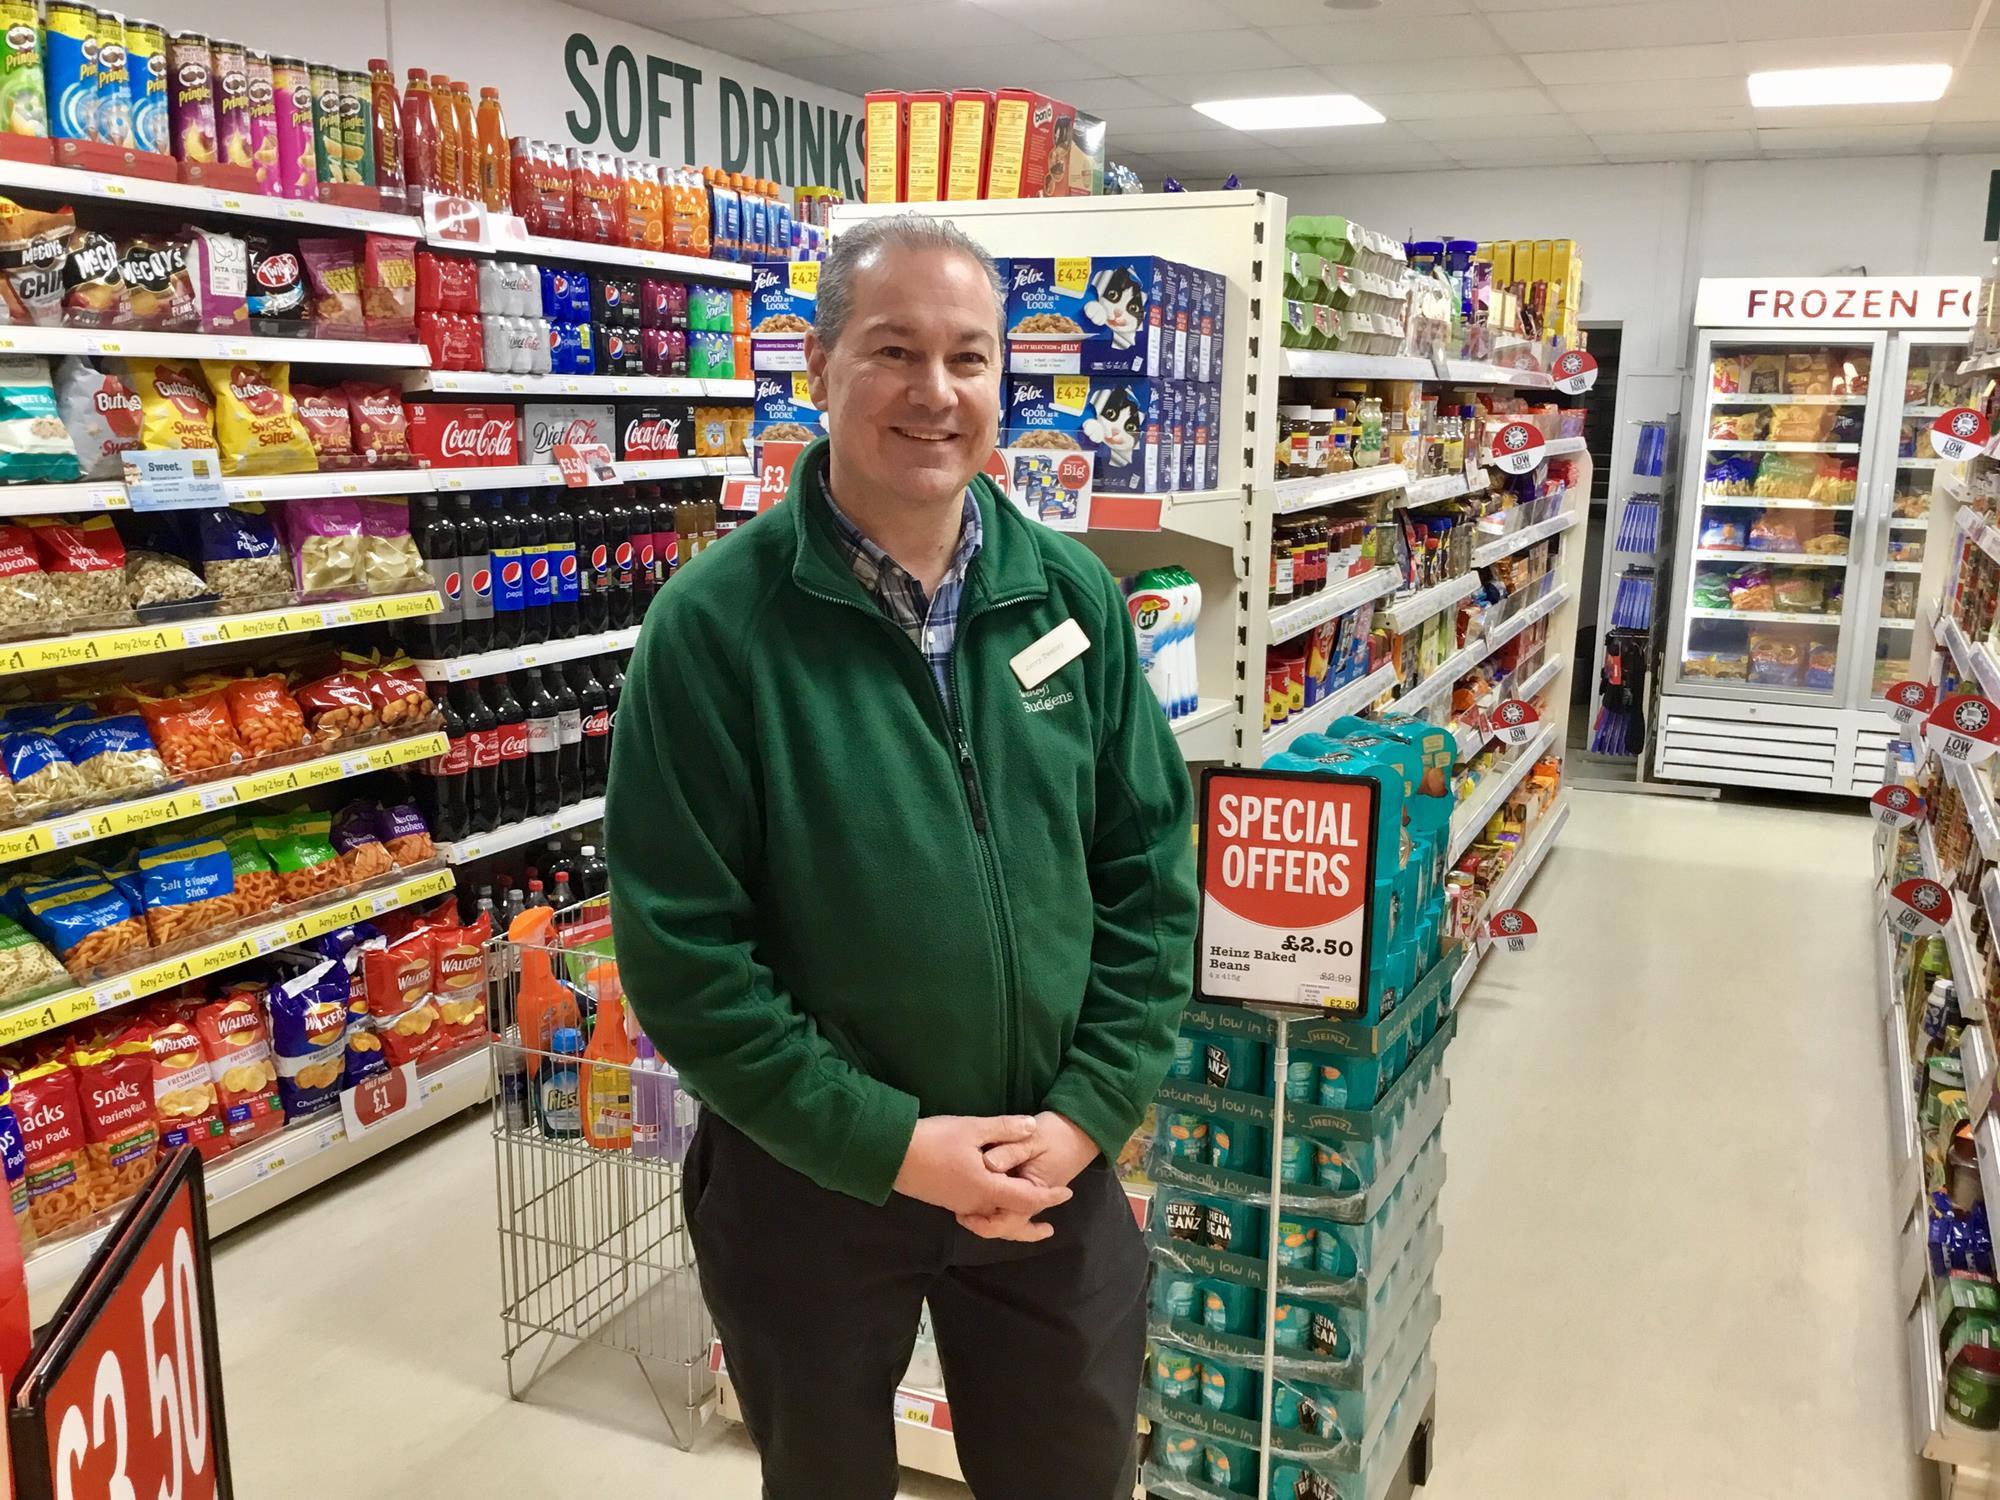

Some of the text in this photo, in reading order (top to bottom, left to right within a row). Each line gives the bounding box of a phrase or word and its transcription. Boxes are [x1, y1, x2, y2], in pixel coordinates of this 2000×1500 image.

[565, 33, 702, 166] SOFT
[791, 272, 818, 285] £4.25
[1057, 269, 1088, 282] £4.25
[761, 294, 783, 303] GOOD
[1022, 292, 1047, 302] GOOD
[1747, 289, 1918, 318] FROZEN
[1060, 344, 1079, 353] JELLY
[1056, 386, 1087, 399] £4.25
[414, 406, 424, 416] 10
[764, 403, 786, 411] GOOD
[1021, 409, 1046, 417] GOOD
[442, 420, 515, 457] Coca-Cola
[534, 422, 564, 454] Diet
[624, 418, 681, 452] Coca-Cola
[1945, 440, 1964, 453] LOW
[1512, 455, 1529, 465] LOW
[1062, 463, 1087, 477] Big
[762, 465, 788, 494] £3.
[375, 604, 386, 618] £1
[278, 617, 289, 632] £1
[1140, 612, 1158, 627] Cif
[219, 624, 230, 640] £1
[154, 633, 167, 649] £1
[85, 642, 98, 659] £1
[10, 651, 24, 669] £1
[1023, 692, 1074, 713] Budgens
[1895, 707, 1911, 719] LOW
[1510, 729, 1526, 737] LOW
[1943, 745, 1968, 761] PRICES
[1945, 737, 1973, 753] LOW
[383, 750, 393, 764] £1
[287, 773, 297, 787] £1
[166, 801, 178, 818] £1
[98, 817, 112, 834] £1
[1217, 794, 1358, 847] SPECIAL
[25, 834, 39, 851] £1
[1222, 844, 1350, 897] OFFERS
[161, 879, 181, 892] Salt
[350, 905, 360, 919] £1
[1900, 909, 1921, 927] LOW
[296, 923, 308, 938] £1
[239, 942, 251, 958] £1
[1281, 935, 1353, 957] £2.50
[1507, 938, 1523, 947] LOW
[1210, 946, 1297, 963] Heinz Baked
[178, 962, 191, 979] £1
[441, 955, 483, 973] WALKERS
[1209, 959, 1250, 972] Beans
[1320, 972, 1352, 983] £2.99
[1330, 999, 1357, 1010] £2.50
[41, 1008, 56, 1026] £1
[1219, 1014, 1243, 1031] low
[1312, 1032, 1345, 1046] HEINZ
[373, 1085, 391, 1113] £1
[1222, 1097, 1245, 1113] low
[1249, 1104, 1263, 1118] in
[99, 1107, 132, 1126] Variety
[1314, 1117, 1348, 1131] HEINZ
[46, 1127, 71, 1144] Pack
[8, 1150, 25, 1168] Pack
[1224, 1178, 1247, 1195] low
[1166, 1203, 1197, 1217] HEINZ
[1219, 1260, 1260, 1281] low in
[56, 1227, 207, 1500] £350
[907, 1410, 929, 1423] £1.49
[1213, 1419, 1253, 1441] low in
